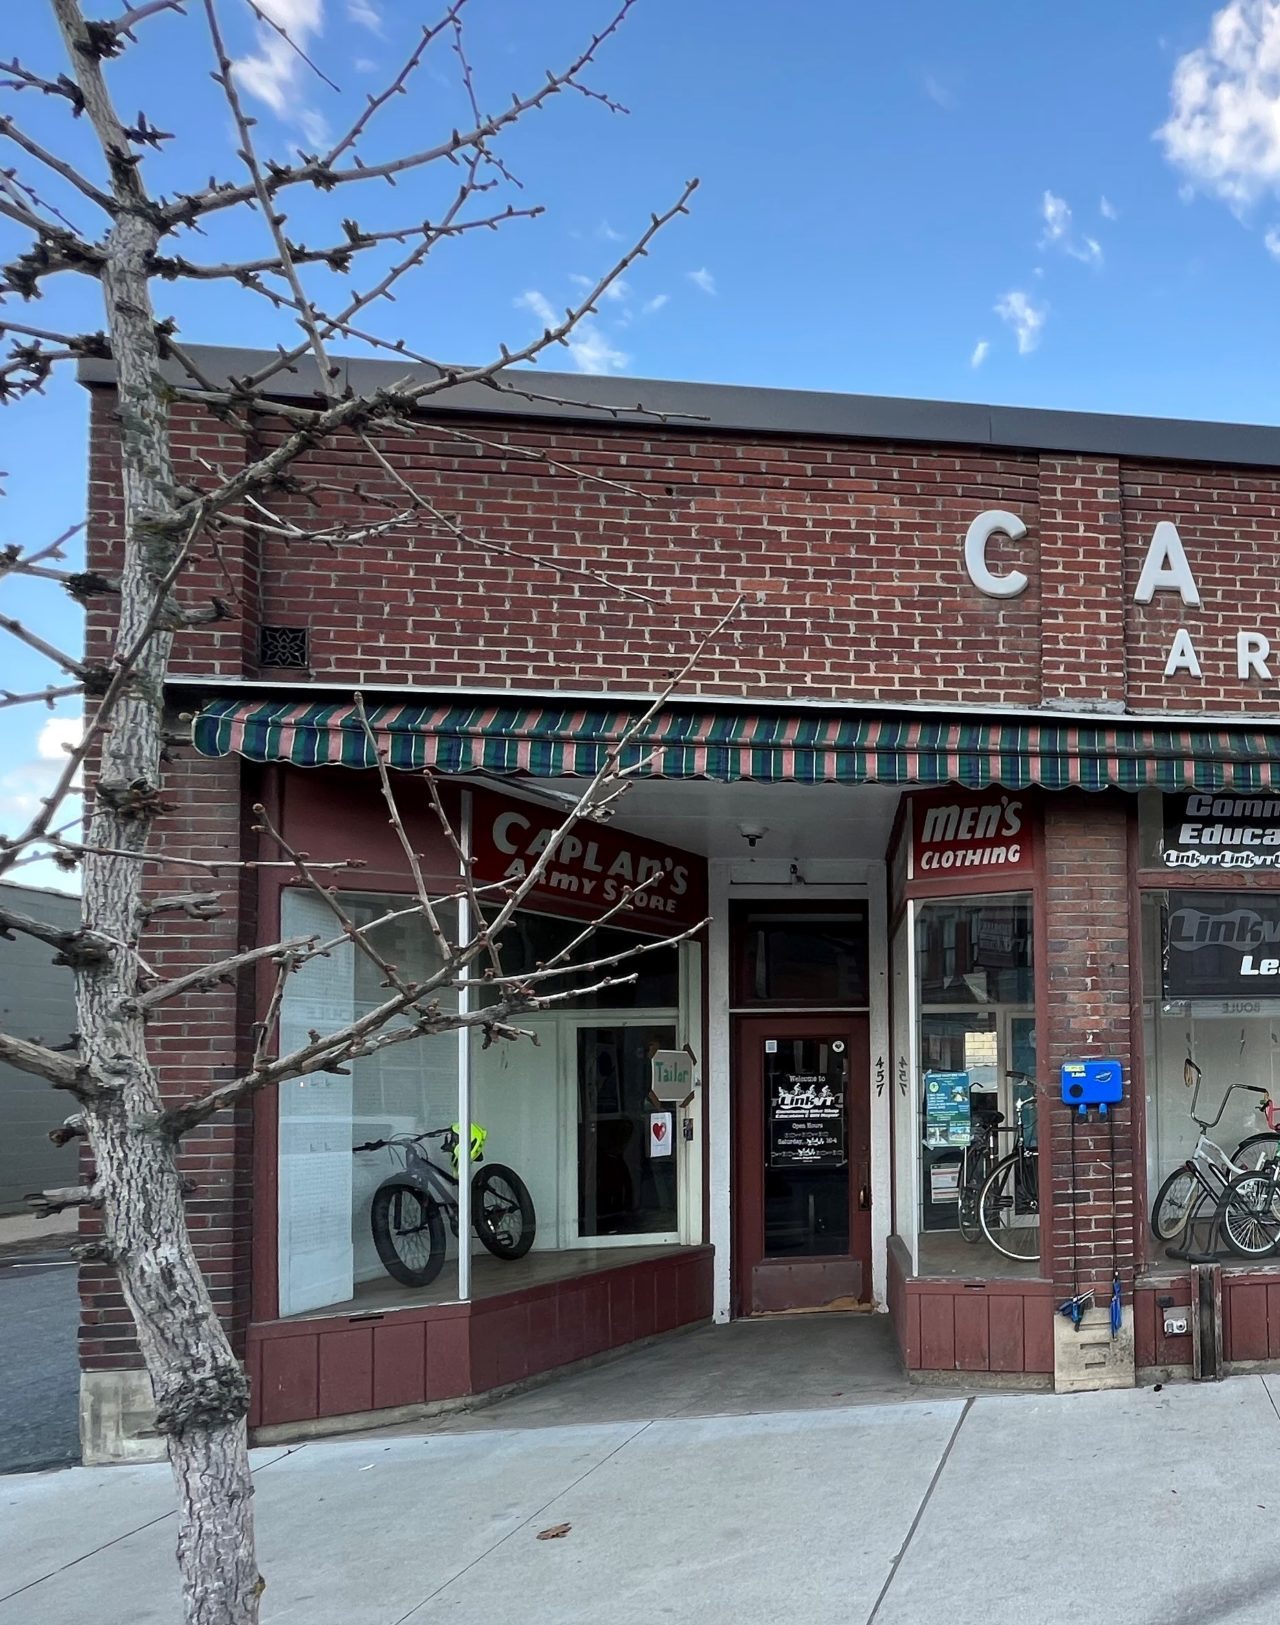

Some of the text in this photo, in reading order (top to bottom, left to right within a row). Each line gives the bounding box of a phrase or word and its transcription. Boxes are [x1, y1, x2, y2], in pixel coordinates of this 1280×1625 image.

[603, 879, 678, 914] SORE
[655, 1061, 689, 1083] Tailor
[875, 1056, 885, 1097] 457
